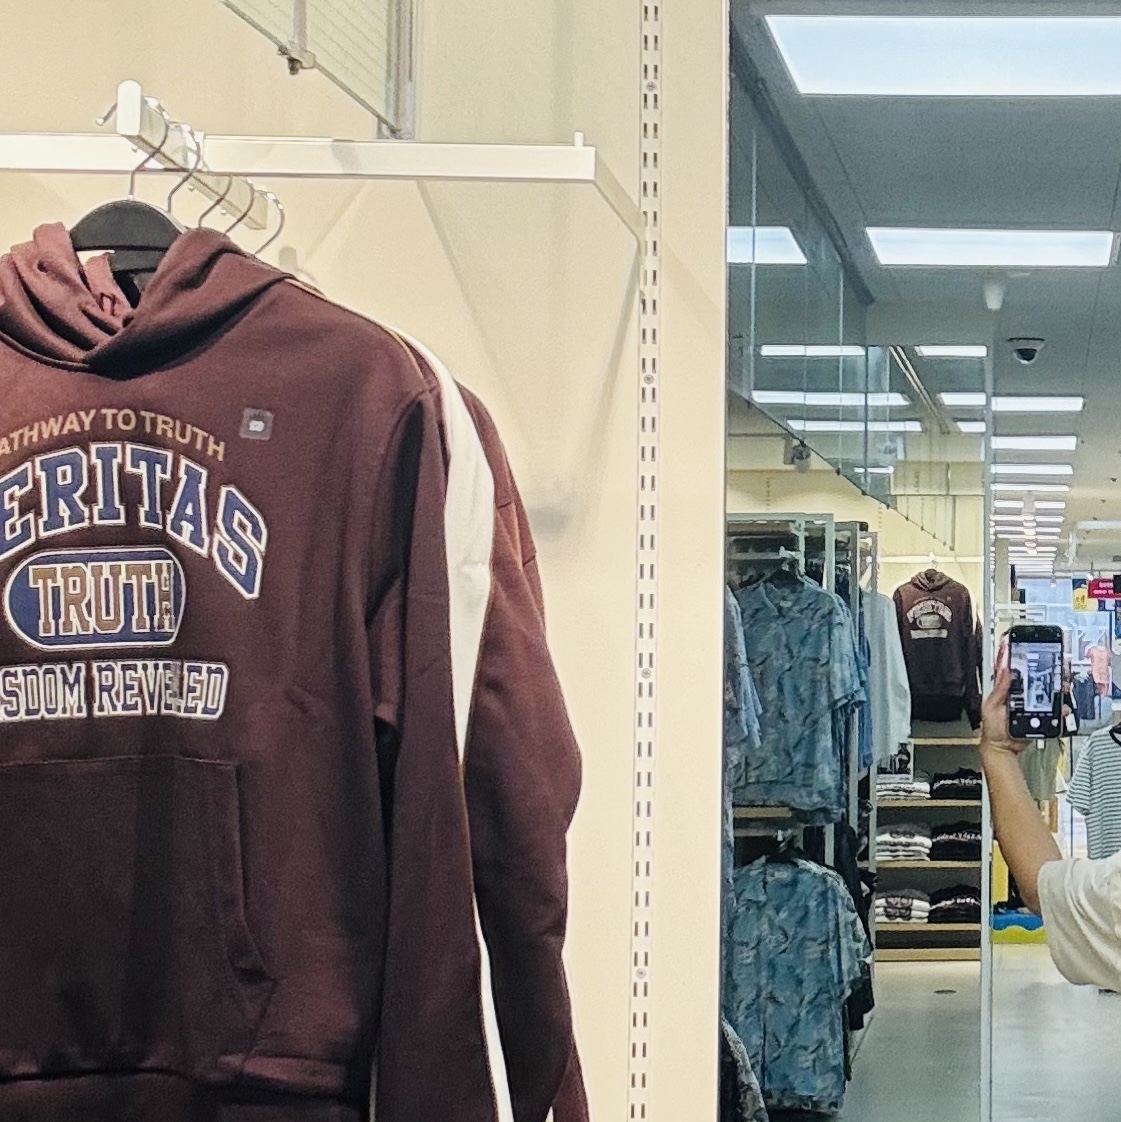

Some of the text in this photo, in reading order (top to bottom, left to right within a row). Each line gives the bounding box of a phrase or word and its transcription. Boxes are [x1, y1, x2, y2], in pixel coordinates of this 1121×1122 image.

[100, 408, 137, 431] TO
[140, 410, 226, 462] TRUTH
[28, 560, 175, 637] TRUTH
